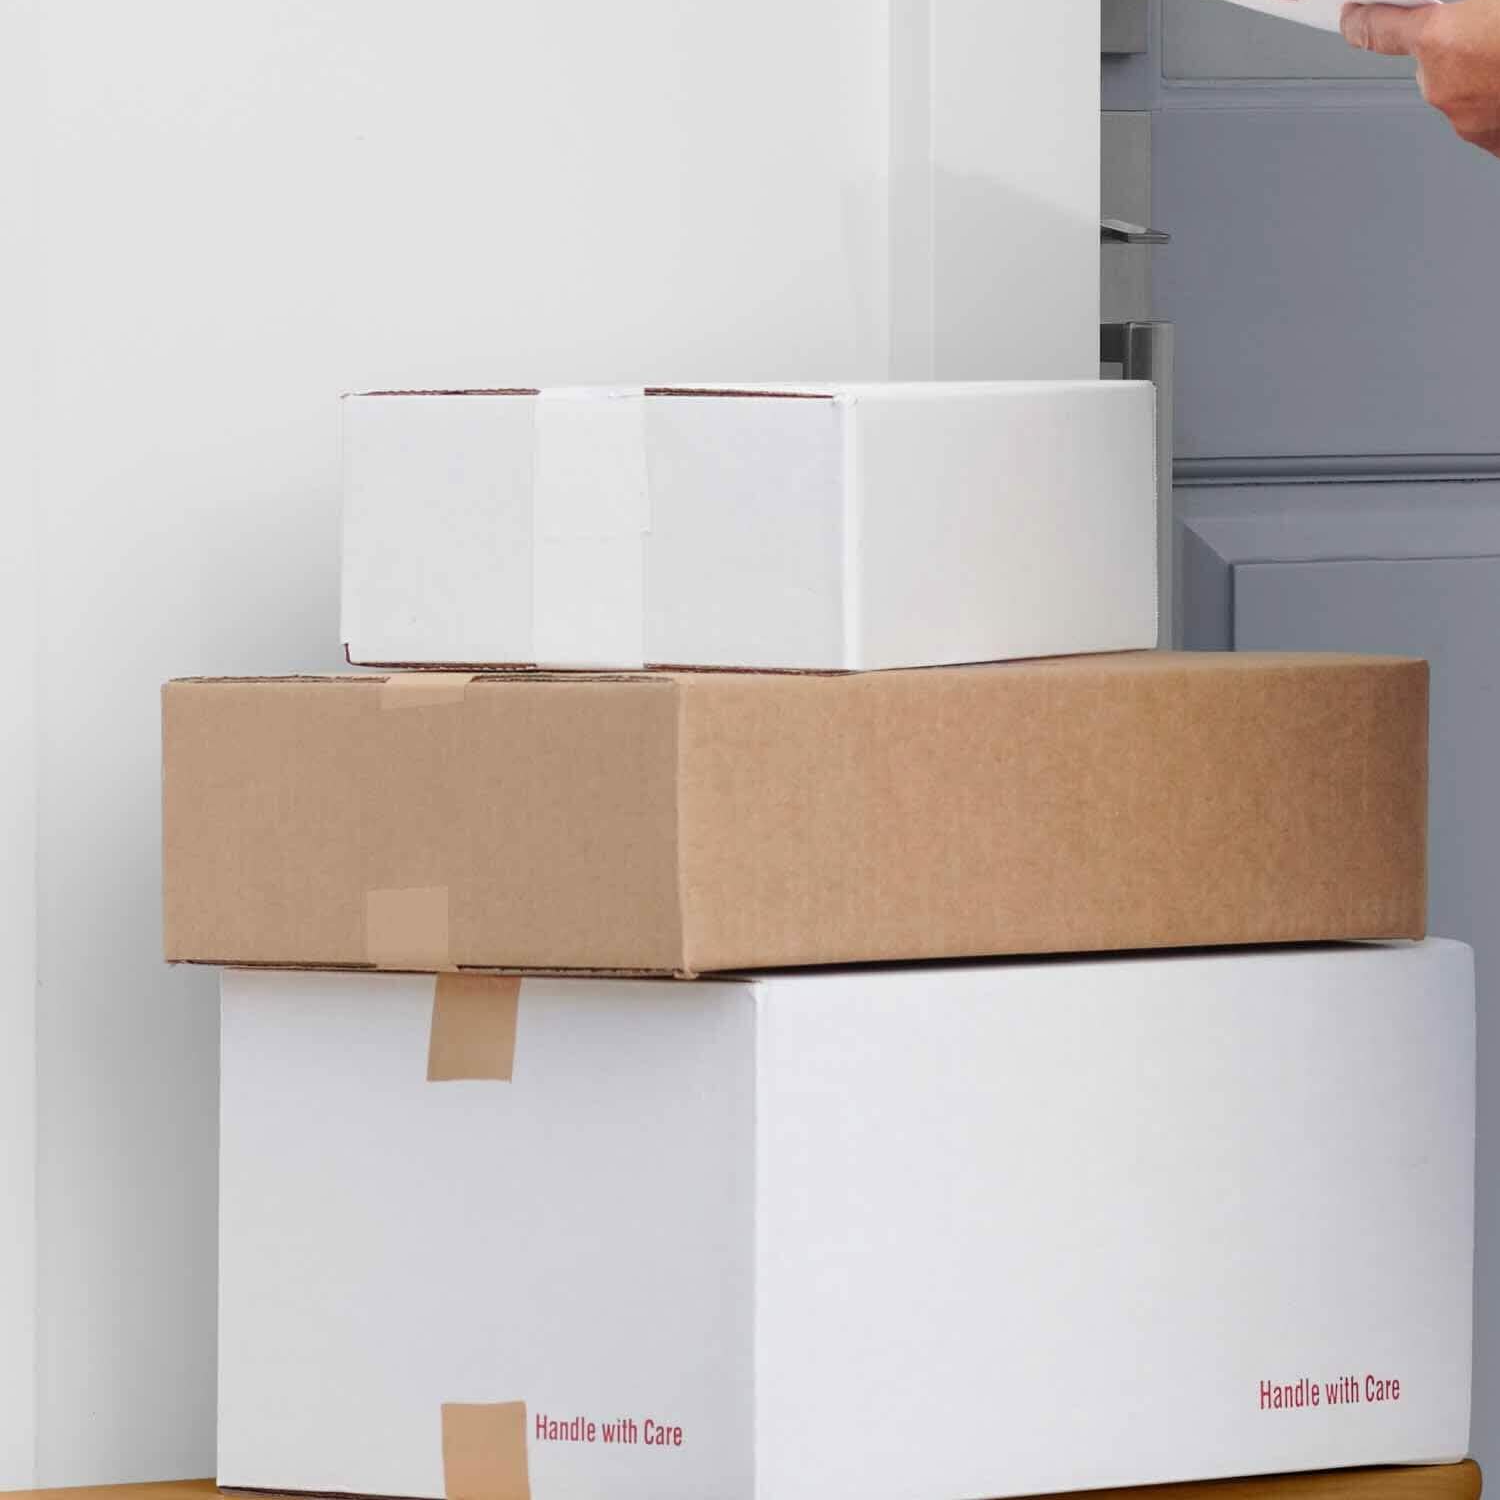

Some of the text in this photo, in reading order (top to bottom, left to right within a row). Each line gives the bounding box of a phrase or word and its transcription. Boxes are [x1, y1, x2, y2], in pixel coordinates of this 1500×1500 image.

[1260, 1374, 1400, 1410] Handle with Care
[536, 1413, 682, 1446] Handle with Care
